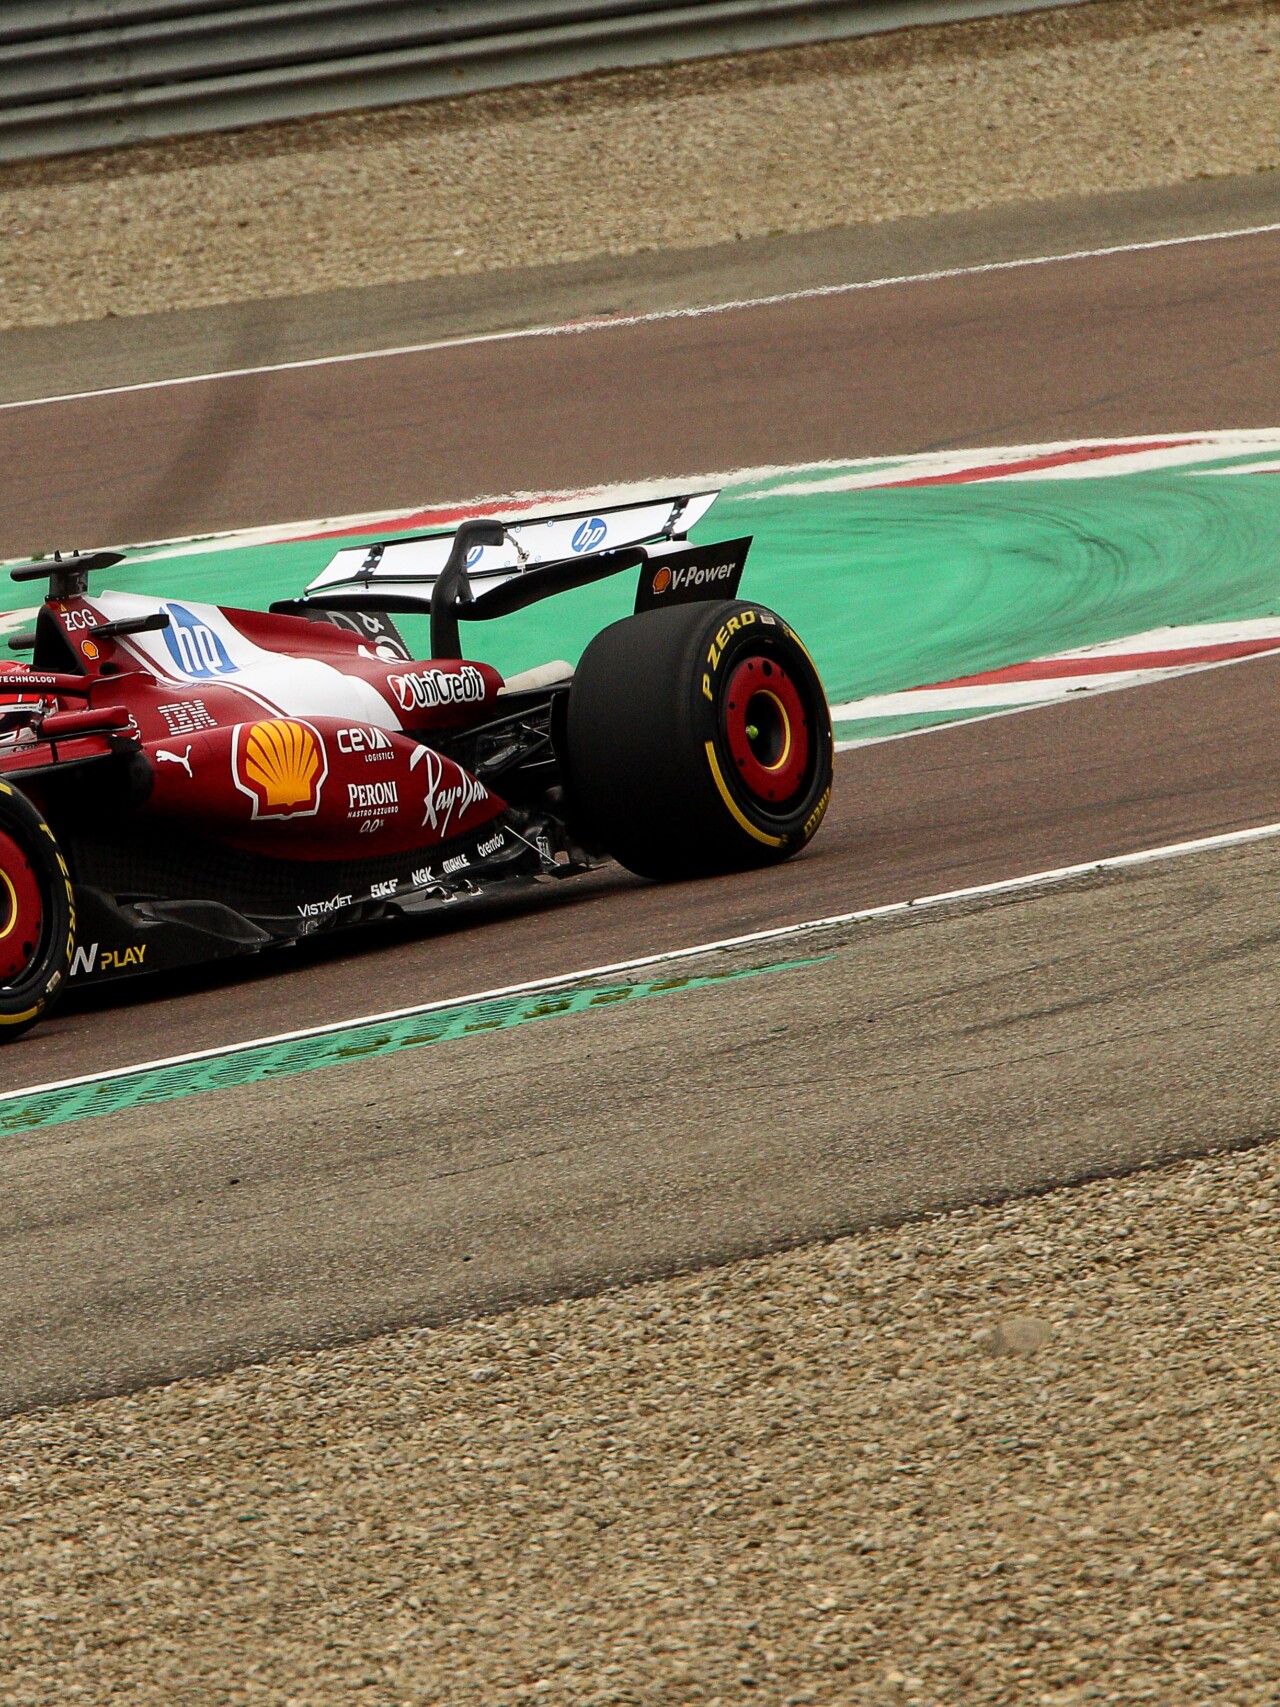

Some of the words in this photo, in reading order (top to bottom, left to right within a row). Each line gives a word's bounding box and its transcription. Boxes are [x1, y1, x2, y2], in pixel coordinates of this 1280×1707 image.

[573, 519, 606, 552] hp
[672, 562, 736, 590] V-Power
[163, 604, 226, 678] hp
[702, 673, 713, 701] P
[708, 610, 756, 671] ZERO
[406, 666, 484, 706] UniCredit
[157, 700, 218, 735] IBM
[364, 752, 395, 763] LOGISTICS
[348, 781, 399, 808] PERONI
[347, 809, 372, 819] NASTRO
[372, 806, 399, 816] AZZURRO
[476, 833, 505, 858] brembo
[411, 866, 436, 886] NGK
[443, 853, 470, 874] MAHLE
[371, 878, 399, 899] SKF
[101, 944, 147, 970] PLAY
